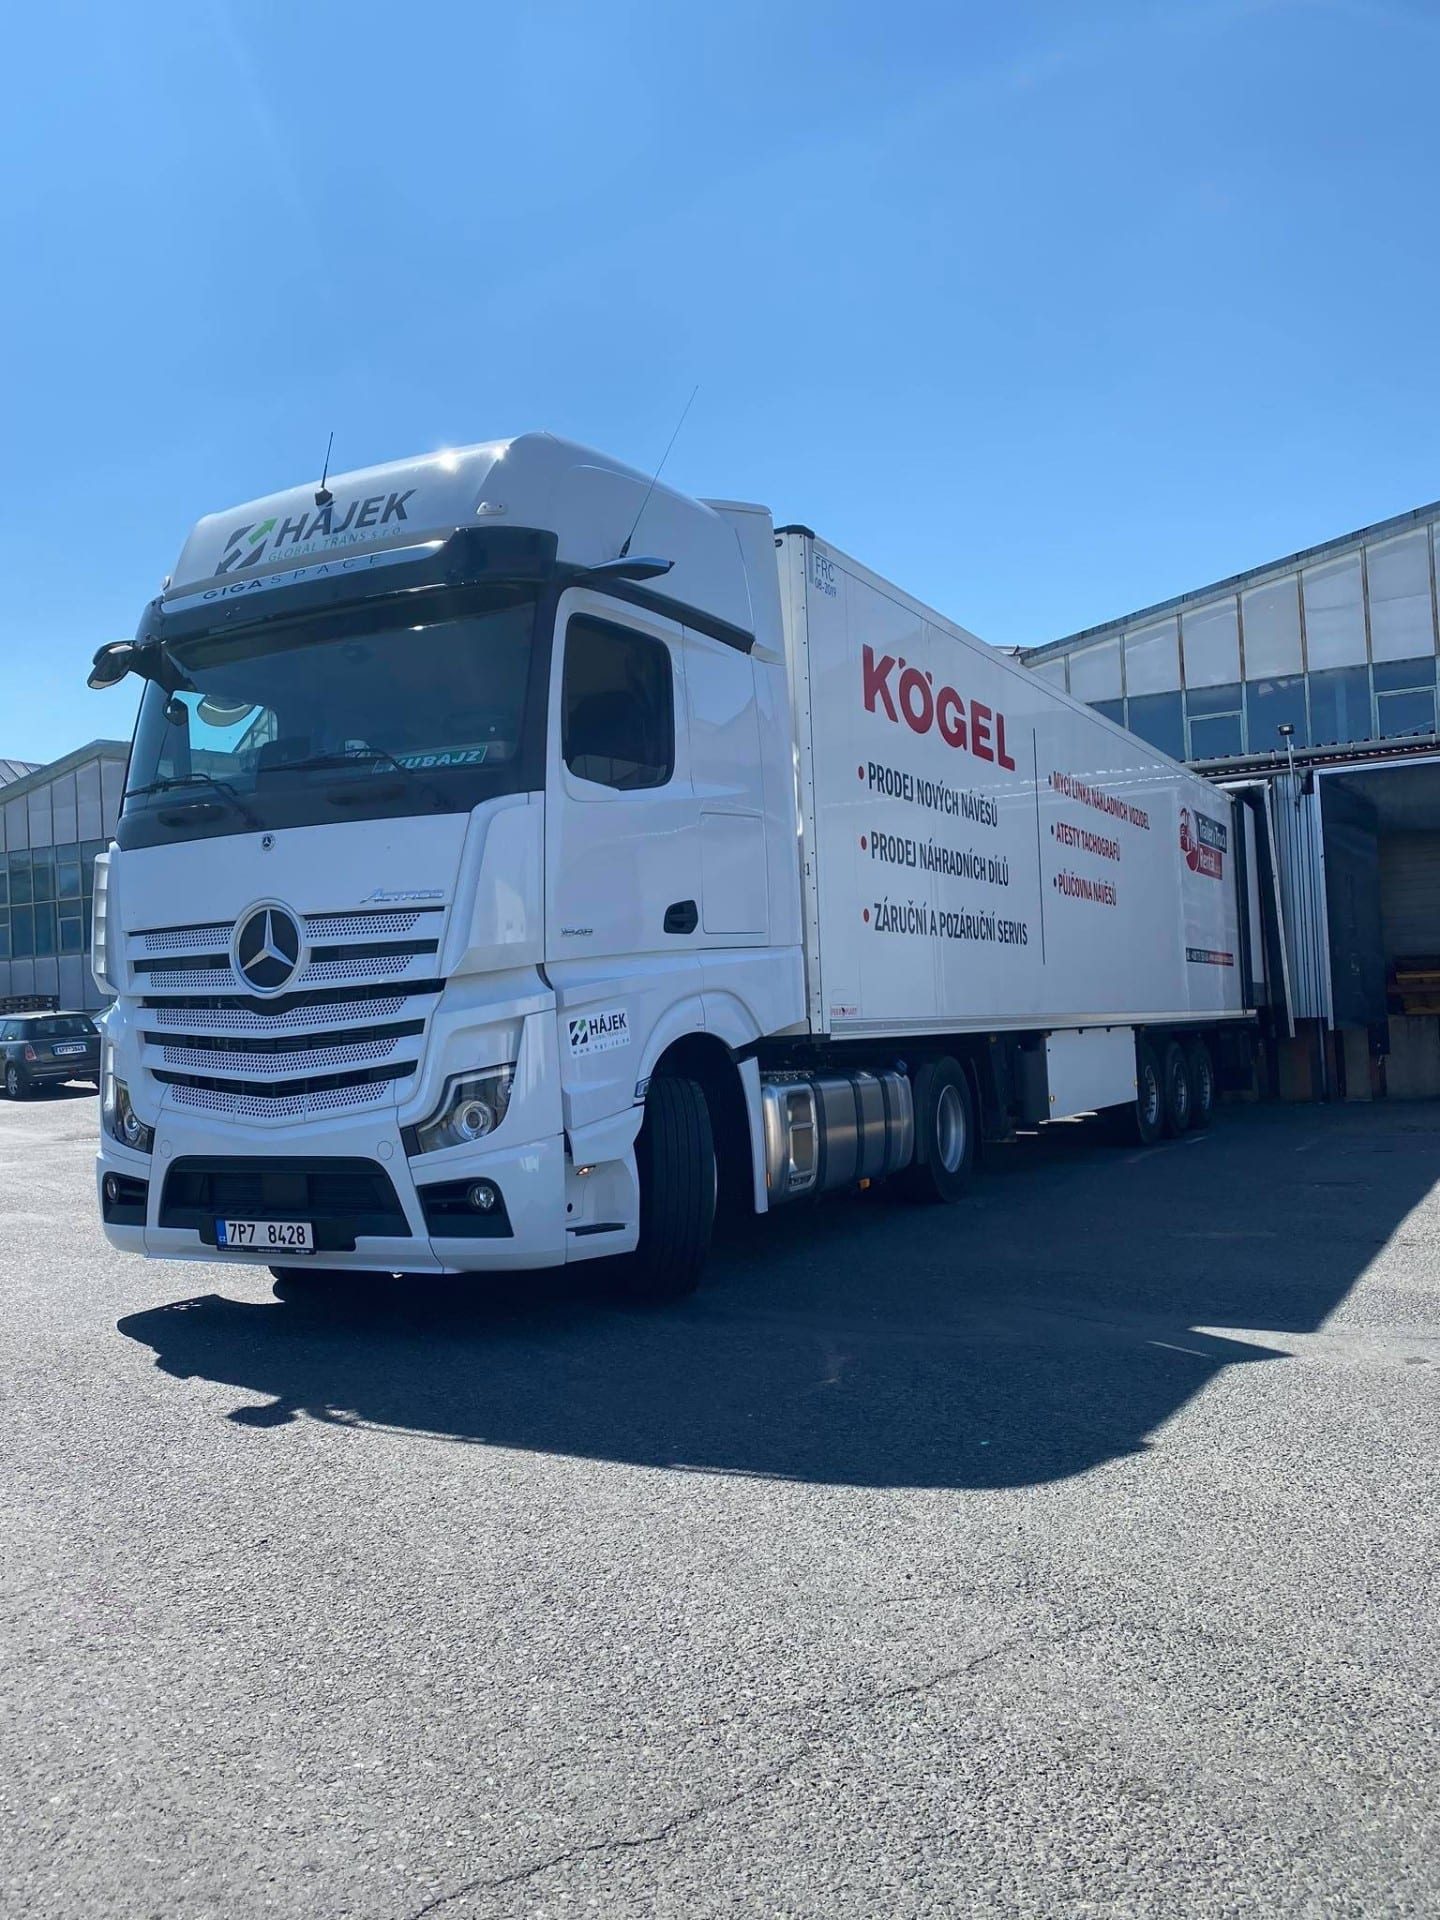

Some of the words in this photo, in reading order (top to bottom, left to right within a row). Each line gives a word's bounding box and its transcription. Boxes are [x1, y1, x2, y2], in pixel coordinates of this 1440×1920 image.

[274, 489, 417, 548] HÁJEK
[269, 544, 317, 561] GLOBAL
[815, 555, 834, 582] FRC
[862, 643, 1016, 771] KÖGEL
[868, 761, 914, 802] PRODEJ
[917, 780, 959, 816] NOVÝCH
[961, 789, 998, 828] NÁVĚSŮ
[1056, 821, 1080, 848] ATESTY
[871, 831, 916, 868] PRODEJ
[919, 837, 986, 881] NÁHRADNÍCH
[988, 855, 1009, 887] DÍLŮ
[1058, 867, 1092, 900] PŮJČOVNA
[874, 896, 927, 935] ZÁRUČNÍ
[929, 910, 938, 936] A
[939, 907, 996, 942] POZÁRUČNÍ
[997, 919, 1028, 946] SERVIS
[589, 1013, 627, 1035] HÁJEK
[228, 1223, 256, 1243] 7P7
[267, 1224, 306, 1245] 8428
